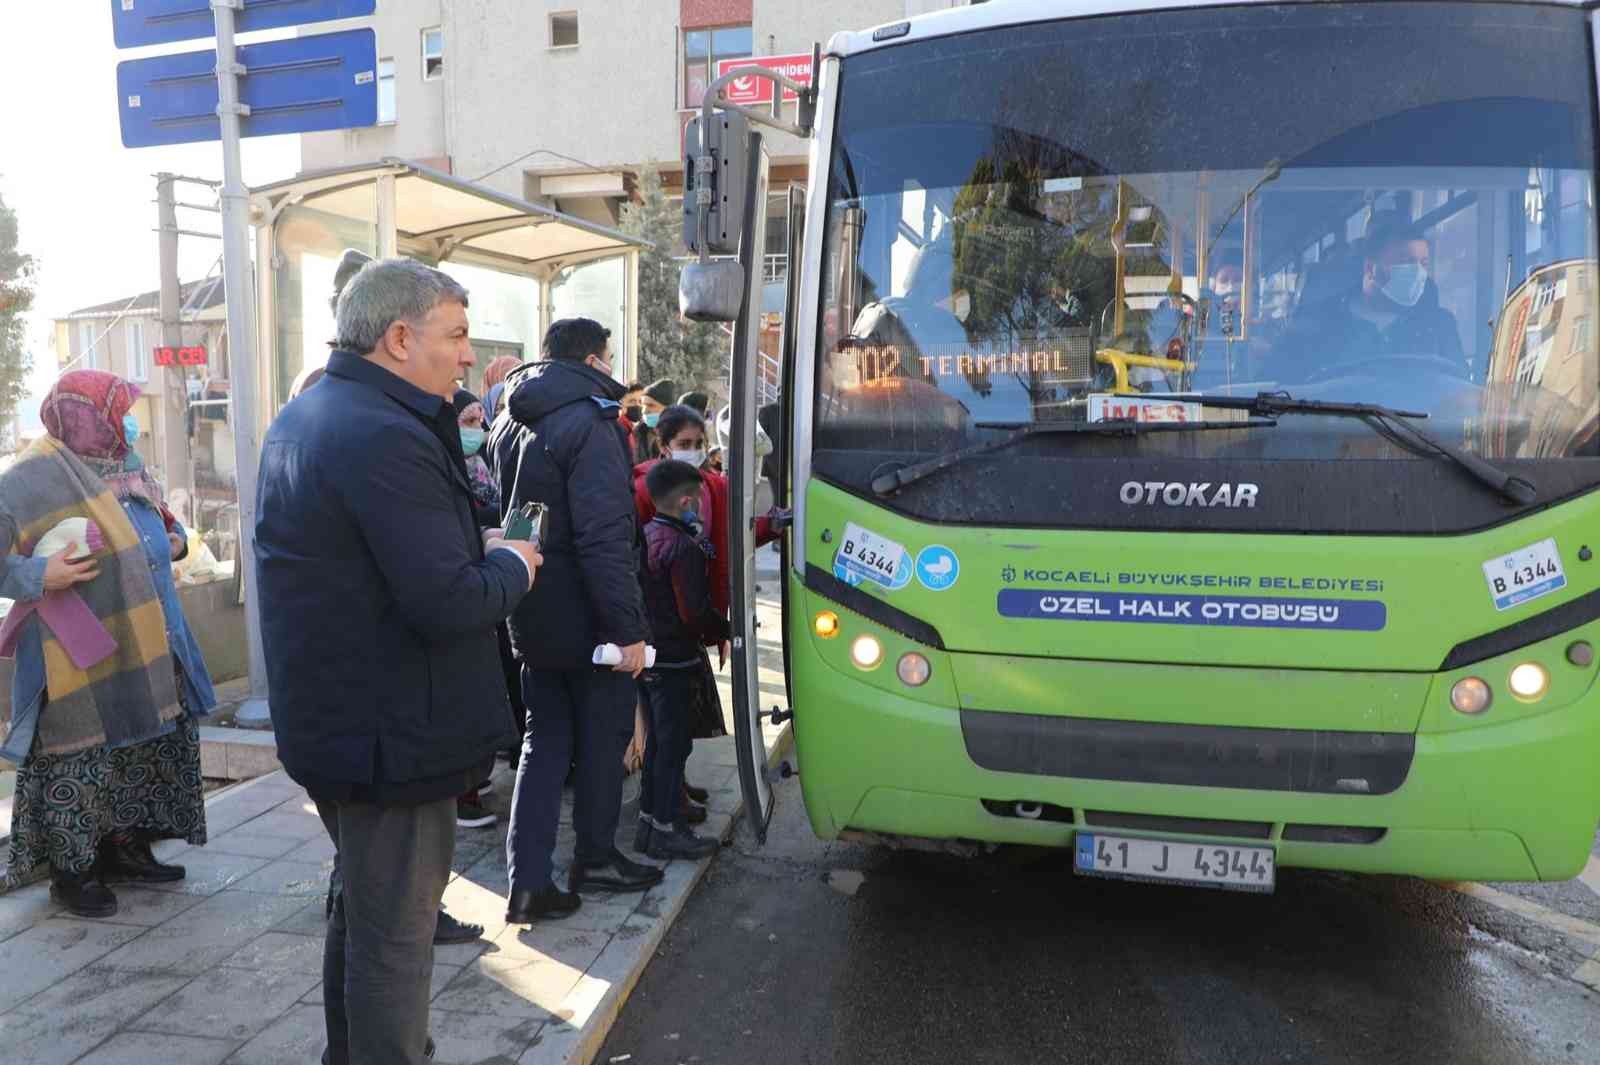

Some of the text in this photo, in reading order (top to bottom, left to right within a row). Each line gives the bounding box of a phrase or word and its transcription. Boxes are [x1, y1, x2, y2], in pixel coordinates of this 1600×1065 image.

[1119, 480, 1259, 508] OTOKAR
[843, 540, 855, 555] B
[857, 547, 895, 576] 4344
[1493, 577, 1507, 594] B
[1513, 557, 1557, 586] 4344
[1039, 595, 1340, 623] ÖZEL HALK OTOBÜSÜ
[1096, 839, 1129, 868] 41
[1151, 845, 1169, 873] J
[1194, 847, 1267, 880] 4344
